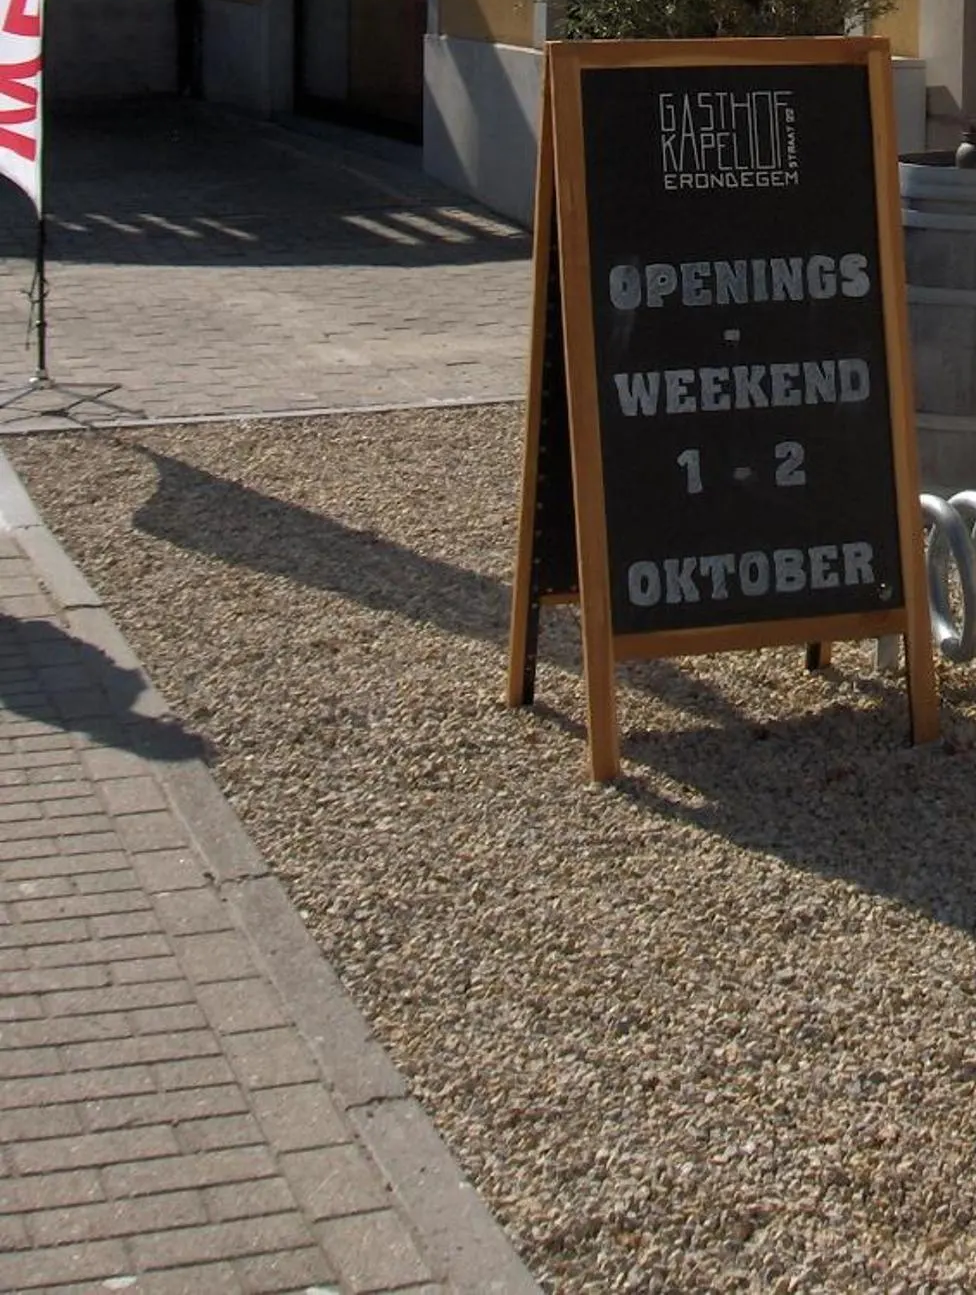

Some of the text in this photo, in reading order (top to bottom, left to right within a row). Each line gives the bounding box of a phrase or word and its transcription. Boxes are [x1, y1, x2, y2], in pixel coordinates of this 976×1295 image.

[664, 171, 799, 191] ERONDEGEM
[608, 253, 871, 311] OPENINGS
[613, 358, 871, 417] WEEKEND
[677, 448, 704, 494] 1
[774, 441, 807, 488] 2
[627, 541, 875, 606] OKTOBER
